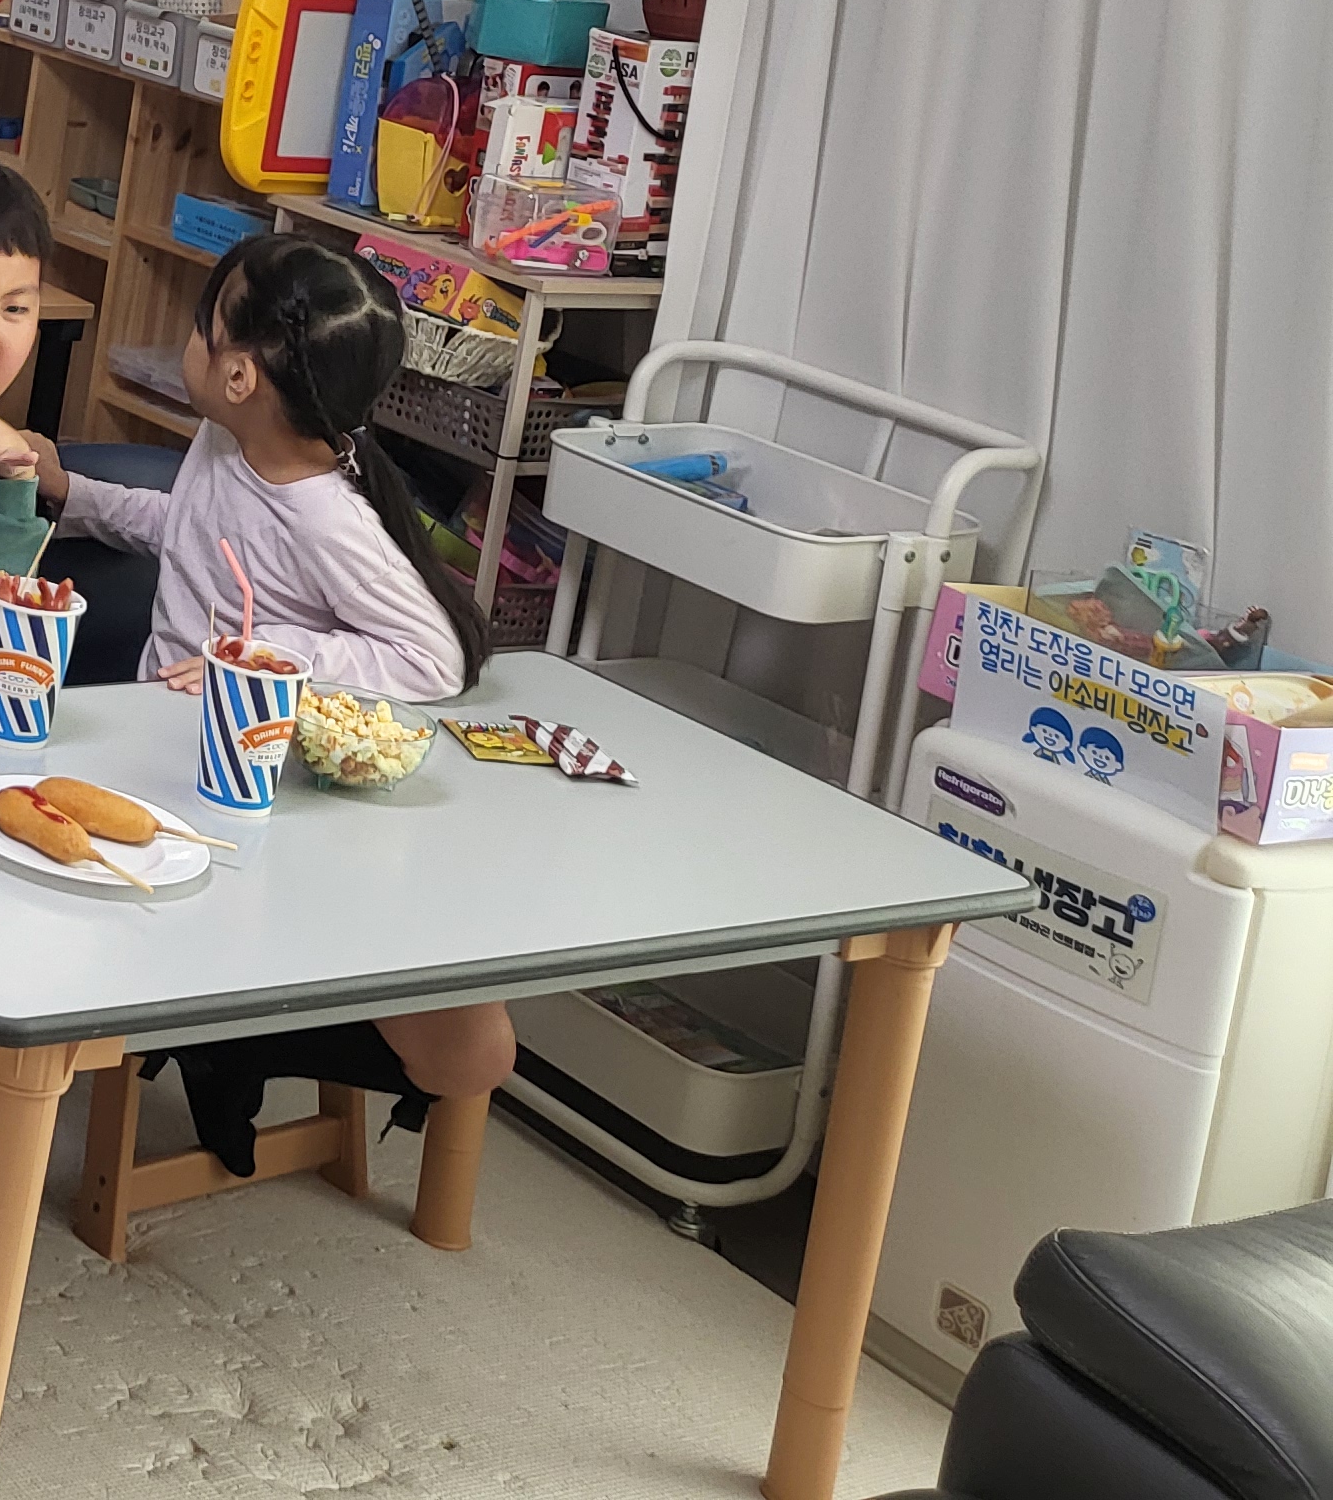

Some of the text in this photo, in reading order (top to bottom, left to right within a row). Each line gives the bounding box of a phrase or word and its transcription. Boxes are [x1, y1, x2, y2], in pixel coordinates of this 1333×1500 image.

[975, 600, 1196, 720] 칭찬 도장을 다 모으면
[979, 638, 1043, 691] 열리는
[1048, 668, 1118, 720] 아소비
[1121, 693, 1196, 754] 냉장고
[253, 727, 281, 742] DRINK
[937, 768, 1004, 807] Refrigerator
[937, 1302, 981, 1330] STEP
[964, 1326, 981, 1349] 2
